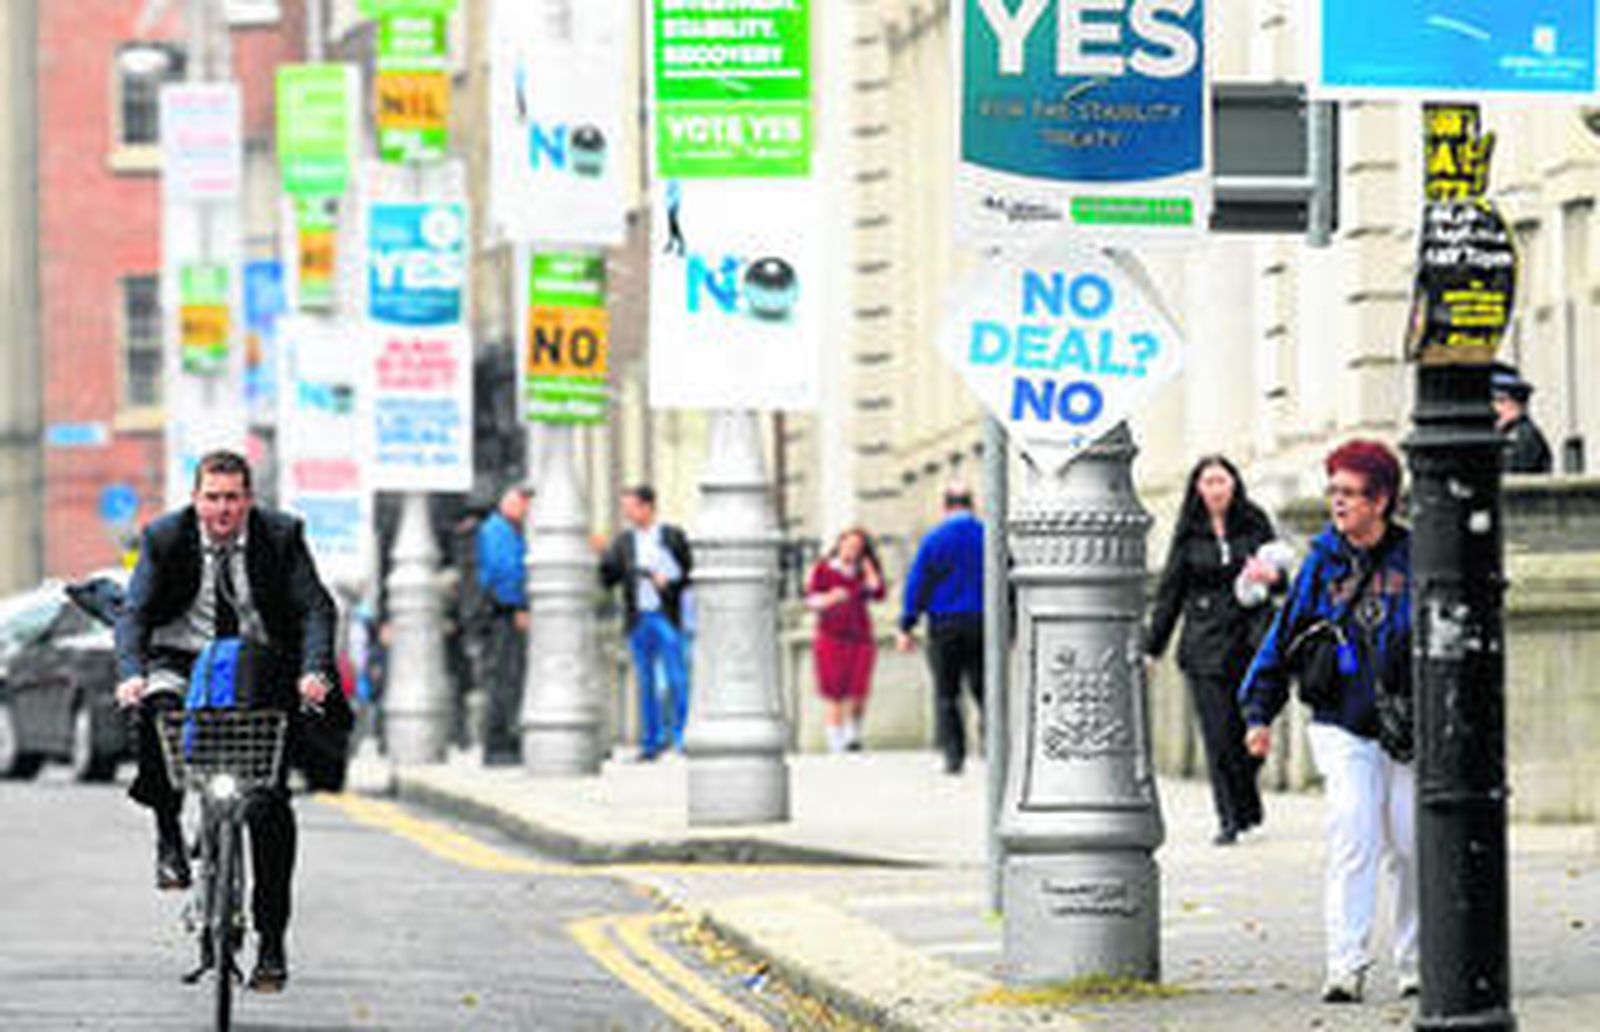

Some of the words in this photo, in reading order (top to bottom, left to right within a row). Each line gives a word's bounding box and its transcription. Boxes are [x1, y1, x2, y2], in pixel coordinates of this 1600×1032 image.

[976, 0, 1199, 77] YES
[665, 115, 742, 143] VOTE
[747, 115, 802, 141] YES
[371, 248, 463, 289] YES
[1023, 270, 1113, 320] NO
[533, 325, 600, 369] NO
[969, 320, 1160, 378] DEAL?
[1011, 376, 1104, 426] NO
